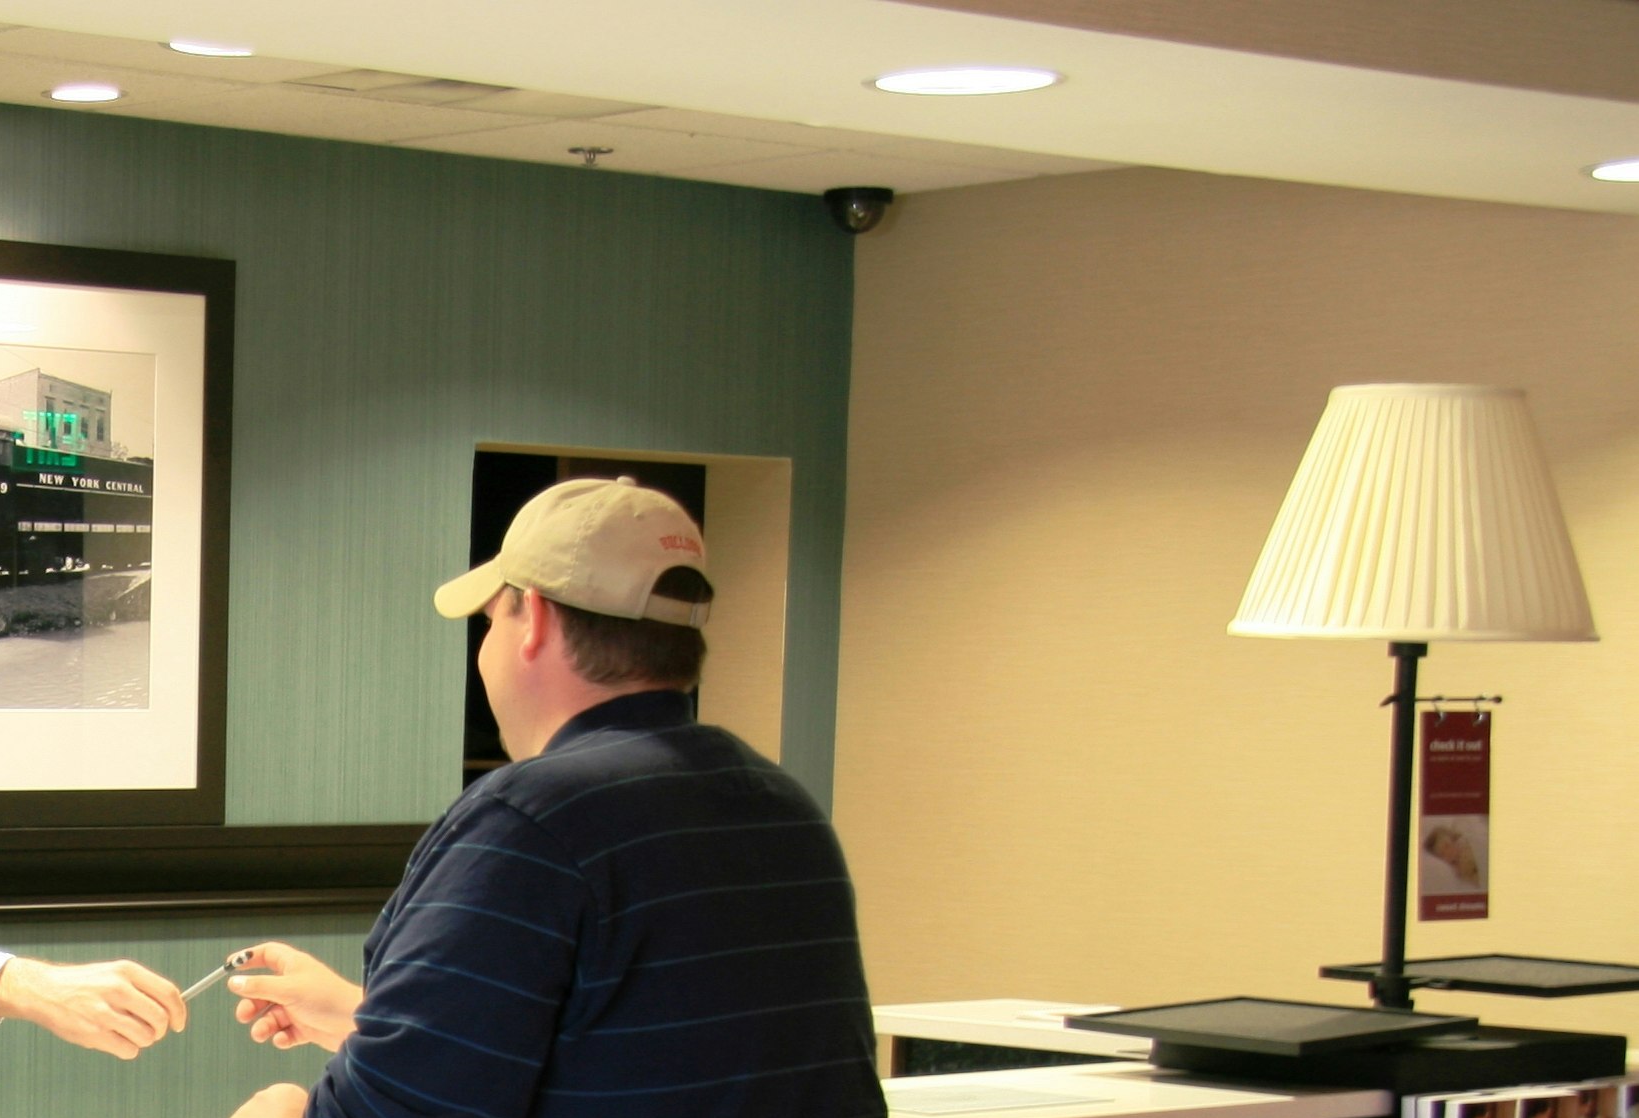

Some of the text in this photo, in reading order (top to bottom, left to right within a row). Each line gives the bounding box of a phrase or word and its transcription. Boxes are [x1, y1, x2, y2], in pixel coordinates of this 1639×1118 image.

[39, 472, 144, 494] NEW YORK CENTRAL
